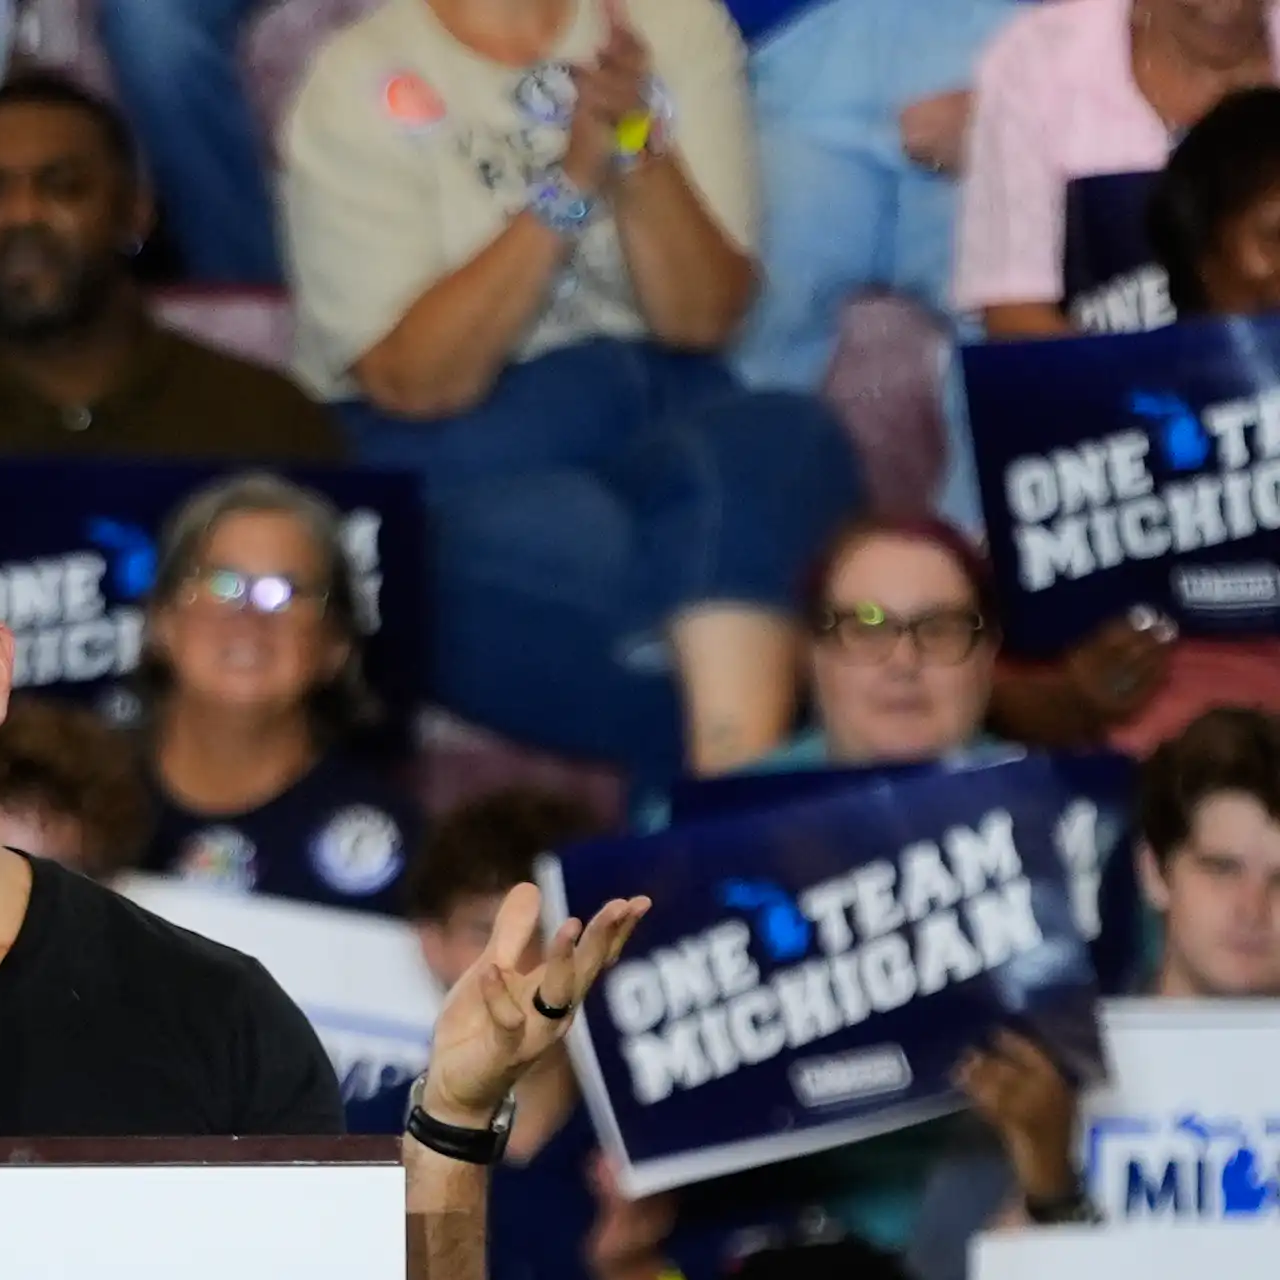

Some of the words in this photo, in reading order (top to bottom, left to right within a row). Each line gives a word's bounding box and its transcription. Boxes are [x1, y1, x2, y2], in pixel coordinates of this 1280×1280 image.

[1006, 430, 1153, 524] ONE
[606, 917, 760, 1035] ONE
[799, 805, 1023, 953] TEAM
[620, 873, 1043, 1105] MICHIGAN
[1124, 1158, 1205, 1218] MI
